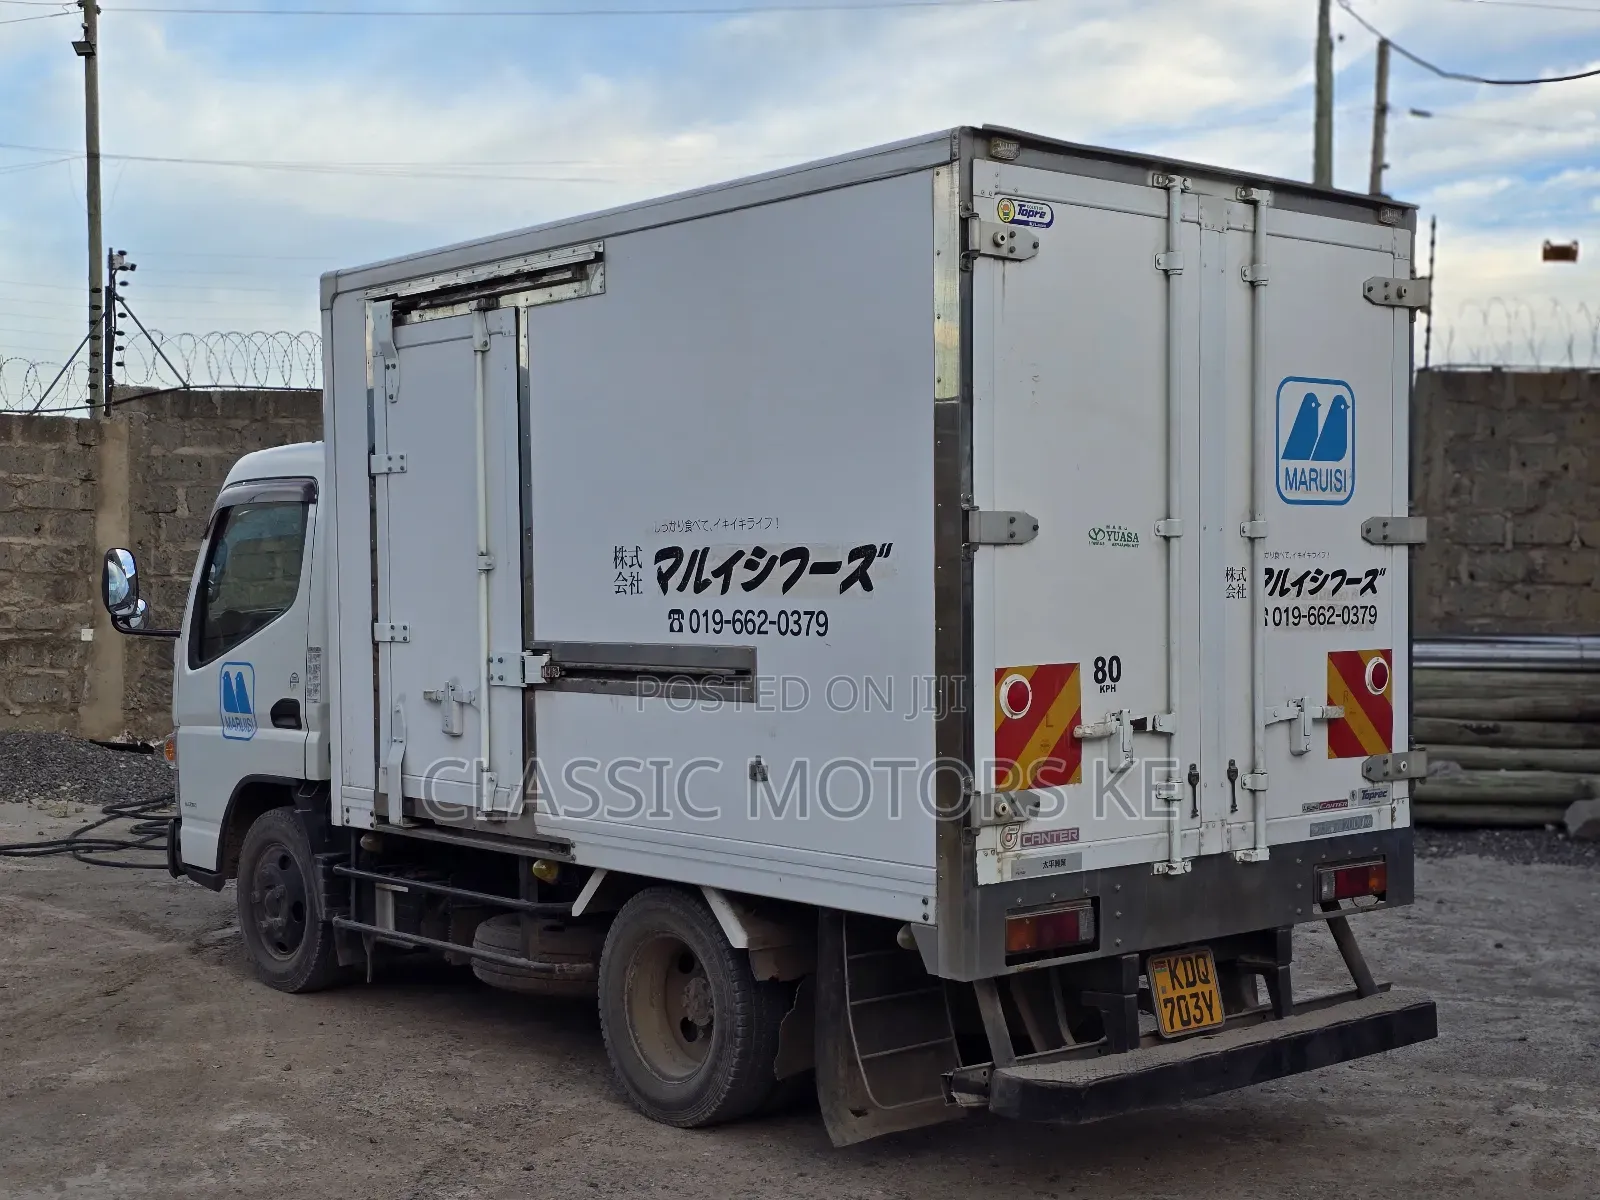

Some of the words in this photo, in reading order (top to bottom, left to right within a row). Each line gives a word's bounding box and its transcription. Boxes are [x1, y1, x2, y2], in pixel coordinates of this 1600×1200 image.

[1017, 203, 1047, 219] Topre
[1284, 466, 1347, 493] MARUISI
[1106, 530, 1139, 543] YUASA
[653, 542, 894, 597] マルイシフーズ
[689, 608, 829, 638] 019-662-0379
[1272, 604, 1378, 627] 019-662-0379
[1093, 655, 1122, 685] 80
[1099, 684, 1117, 694] KPH
[224, 715, 255, 733] MARUISI
[1022, 828, 1078, 847] CANTER
[1166, 954, 1211, 991] KDQ
[1162, 989, 1215, 1030] 703Y
